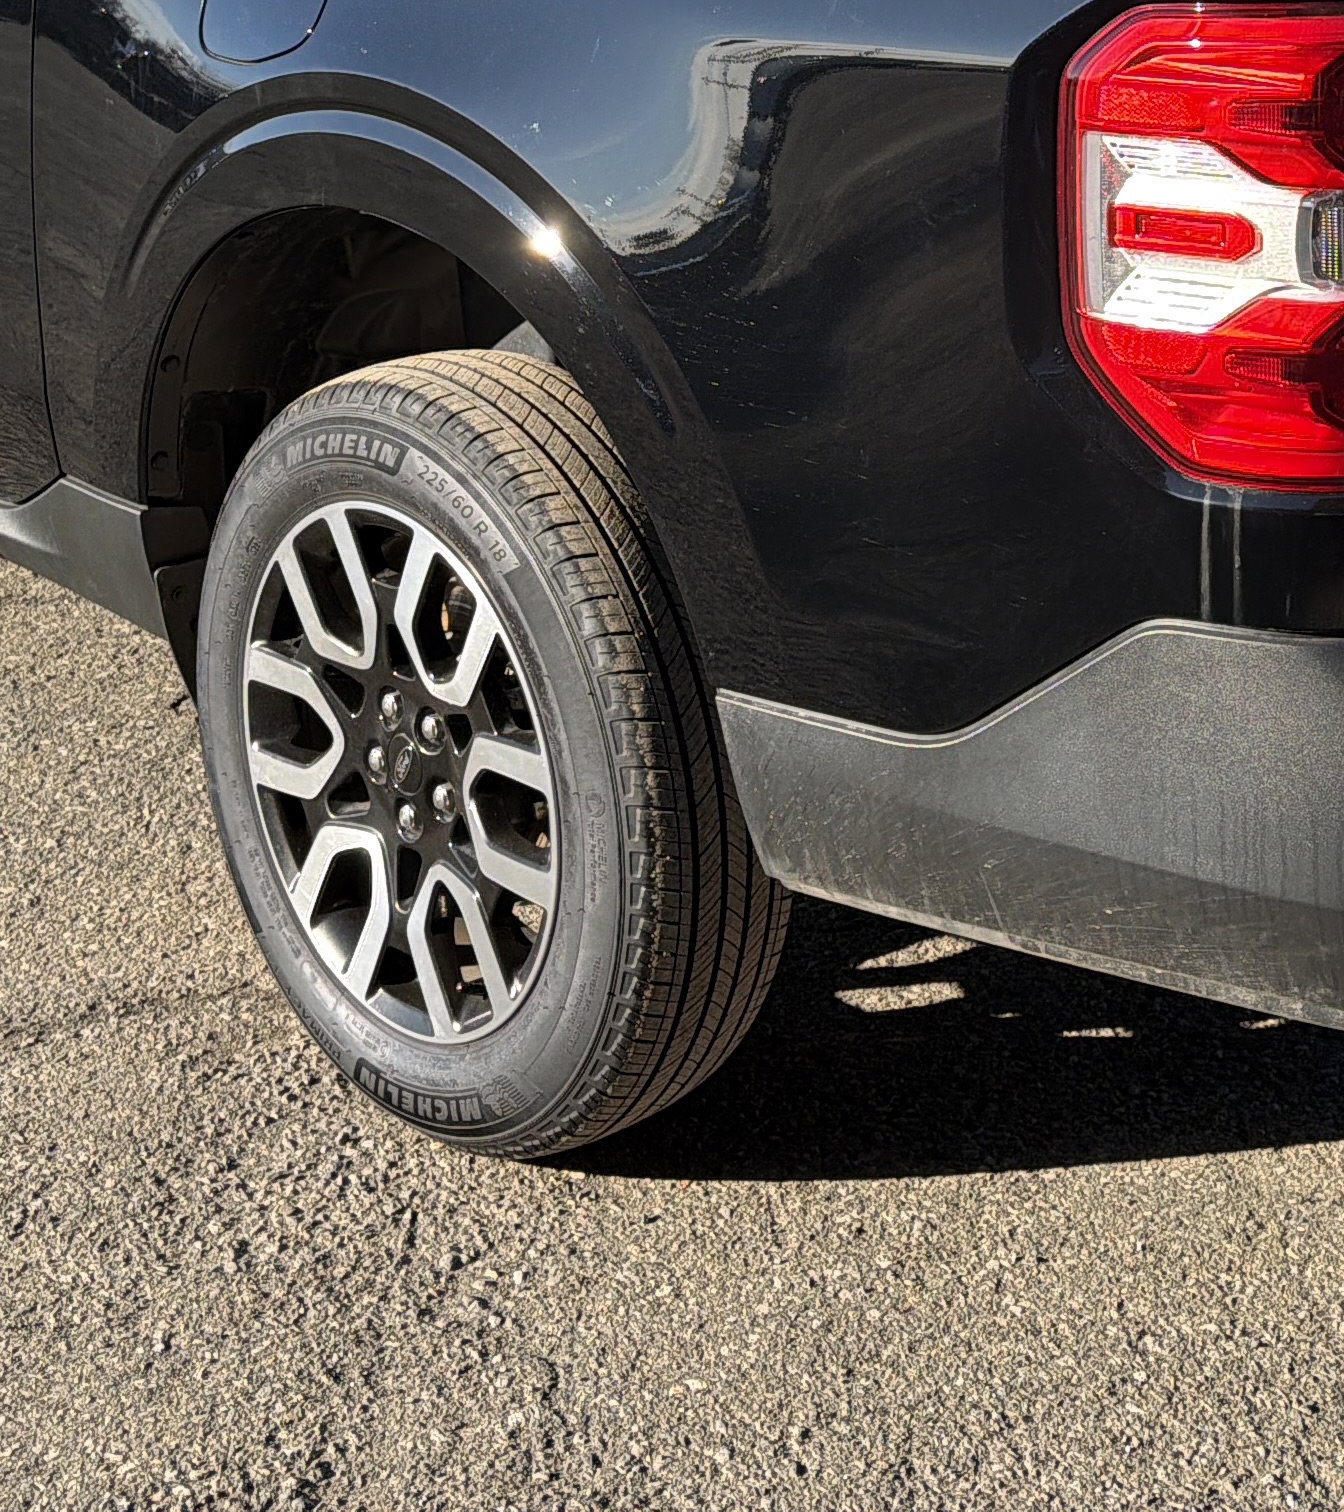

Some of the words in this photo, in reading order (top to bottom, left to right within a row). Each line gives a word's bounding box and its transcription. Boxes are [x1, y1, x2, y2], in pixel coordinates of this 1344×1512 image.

[286, 434, 401, 469] MICHELIN
[416, 464, 474, 520] 225/60
[473, 520, 489, 538] R
[488, 541, 508, 564] 18
[359, 1066, 483, 1123] MICHELIN
